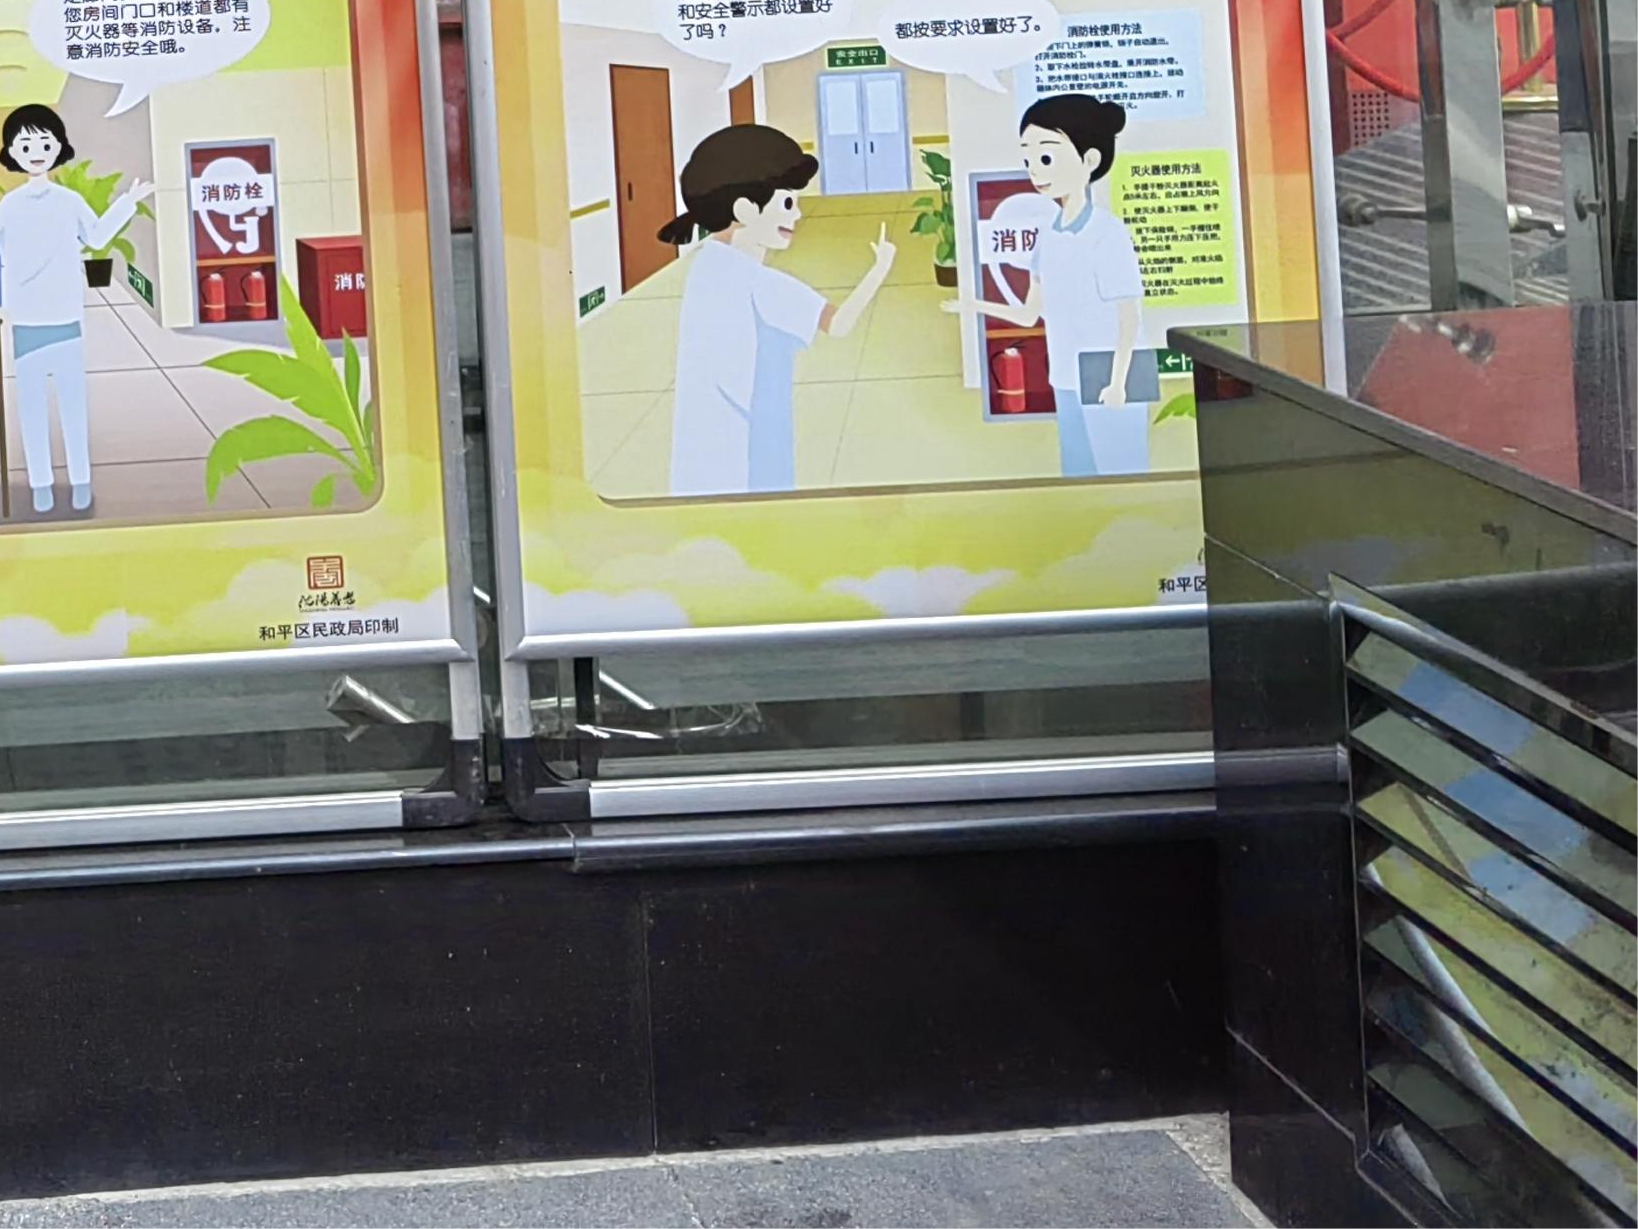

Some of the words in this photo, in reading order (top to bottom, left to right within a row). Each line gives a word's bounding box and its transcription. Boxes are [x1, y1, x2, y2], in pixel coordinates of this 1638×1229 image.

[681, 23, 727, 41] 了吗？
[894, 17, 1042, 39] 都按要求设置好了。
[1067, 22, 1142, 38] 消防栓使用方法
[66, 39, 188, 60] 意消防安全哦。
[201, 182, 264, 203] 消防栓
[1158, 575, 1206, 593] 和平区
[258, 617, 399, 641] 和平区民政局印制
